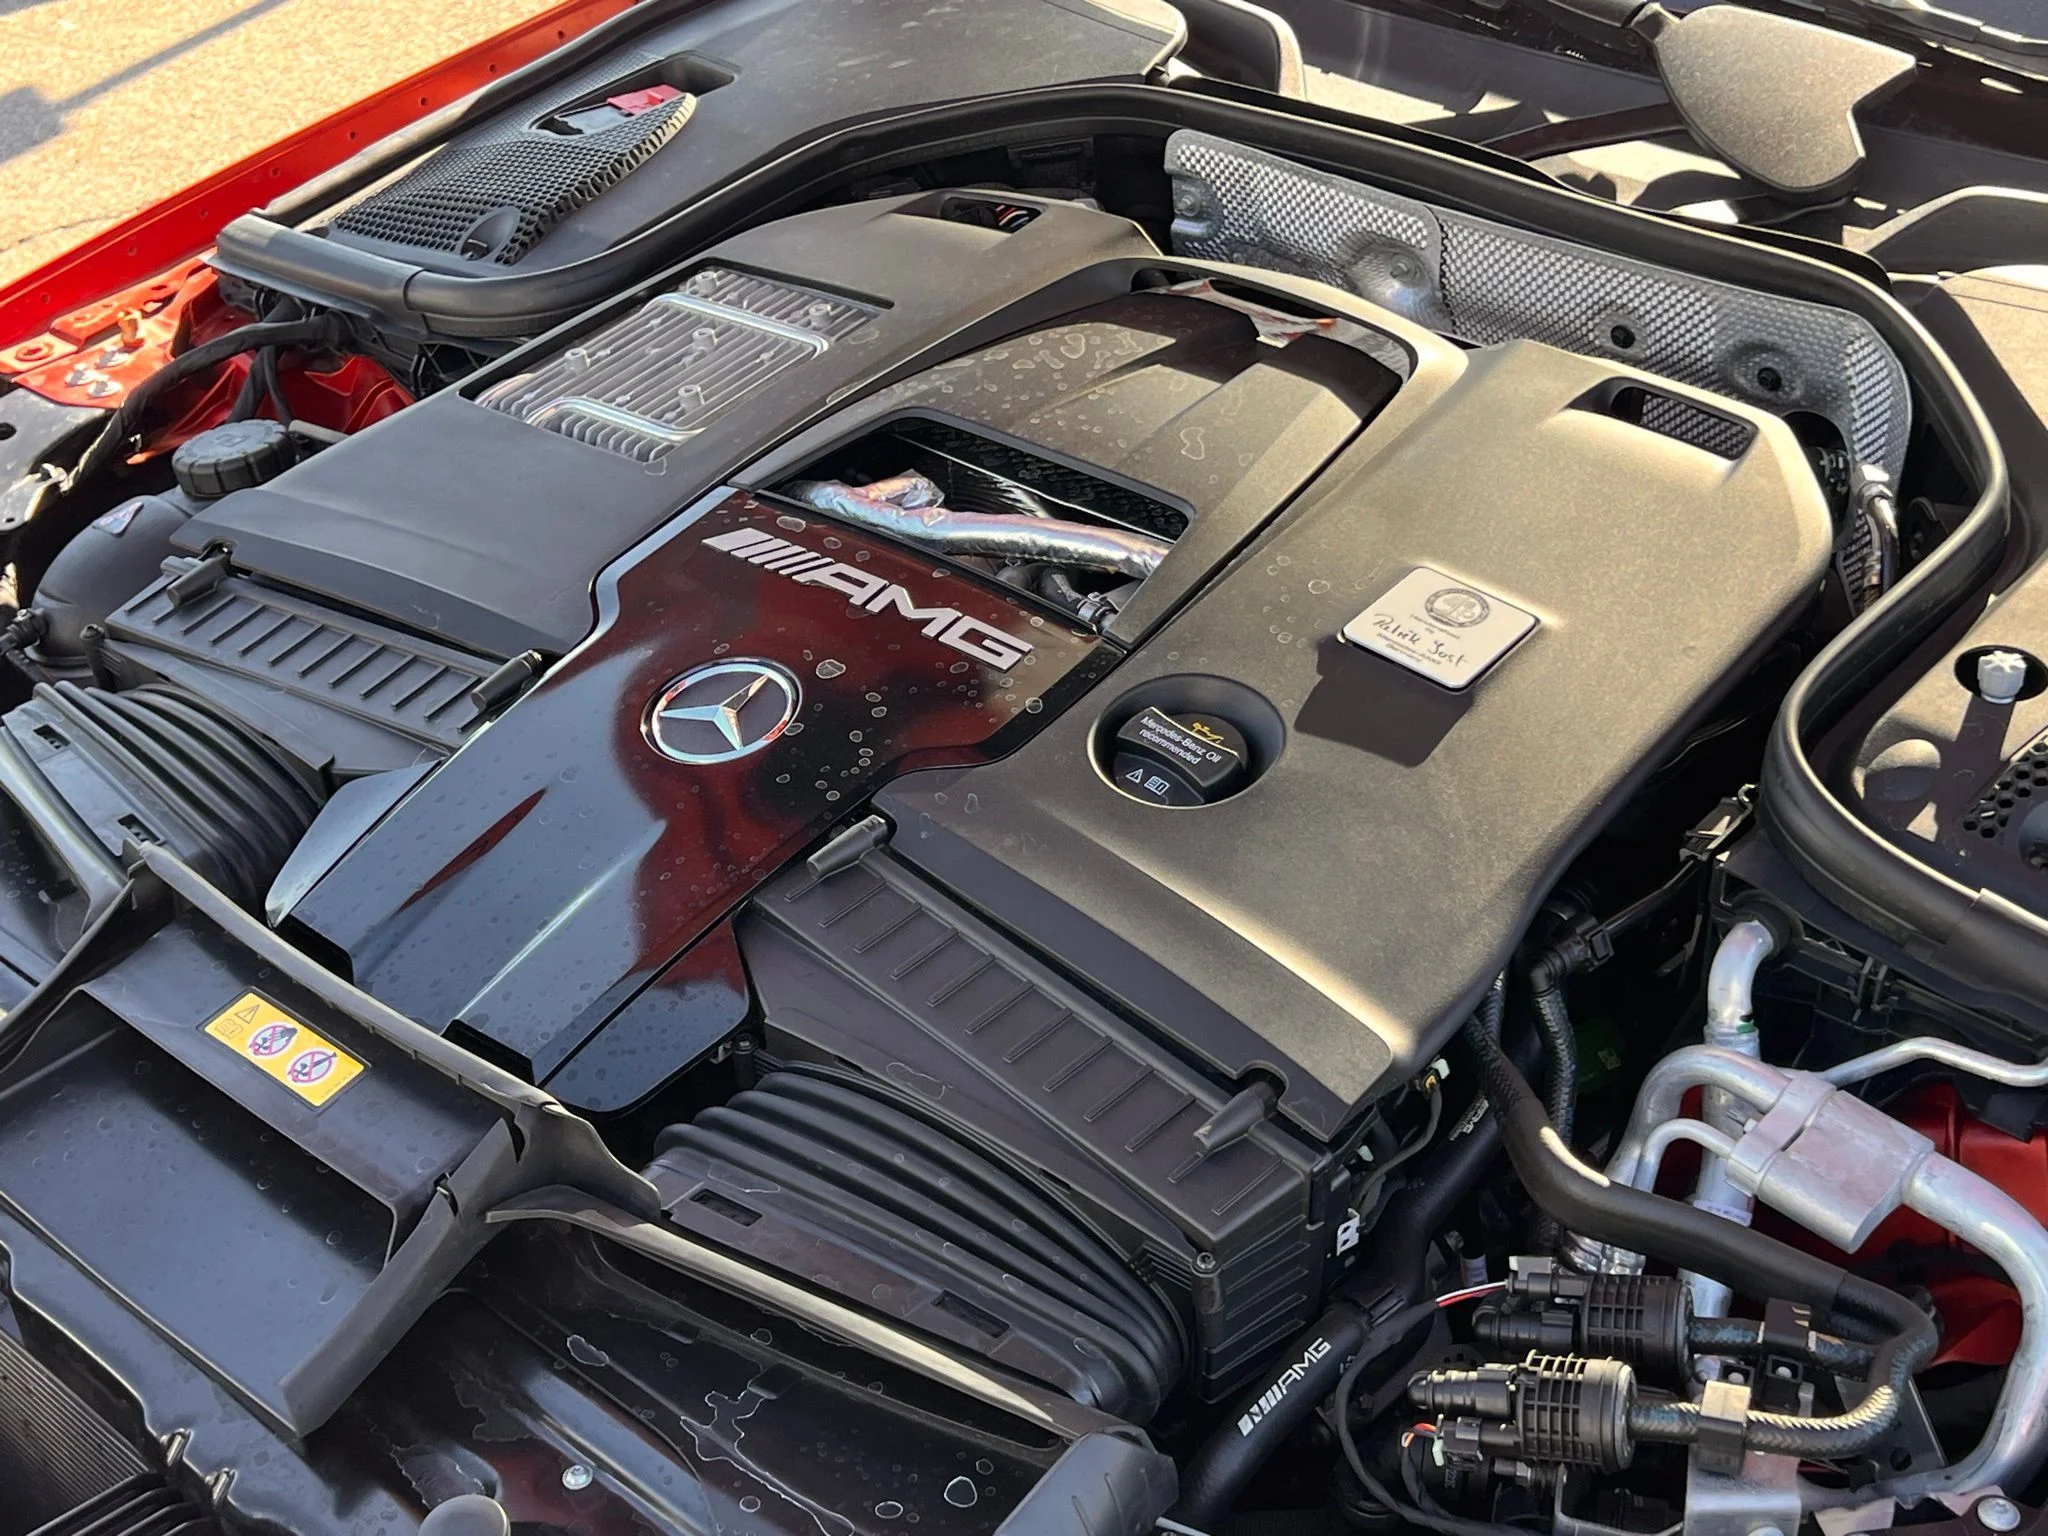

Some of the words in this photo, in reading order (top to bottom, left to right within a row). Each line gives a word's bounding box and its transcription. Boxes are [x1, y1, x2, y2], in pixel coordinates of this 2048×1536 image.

[789, 560, 1034, 673] AMG
[1138, 728, 1202, 765] recommended
[1140, 715, 1206, 756] Mercedes-Benz
[1205, 750, 1222, 763] Oil
